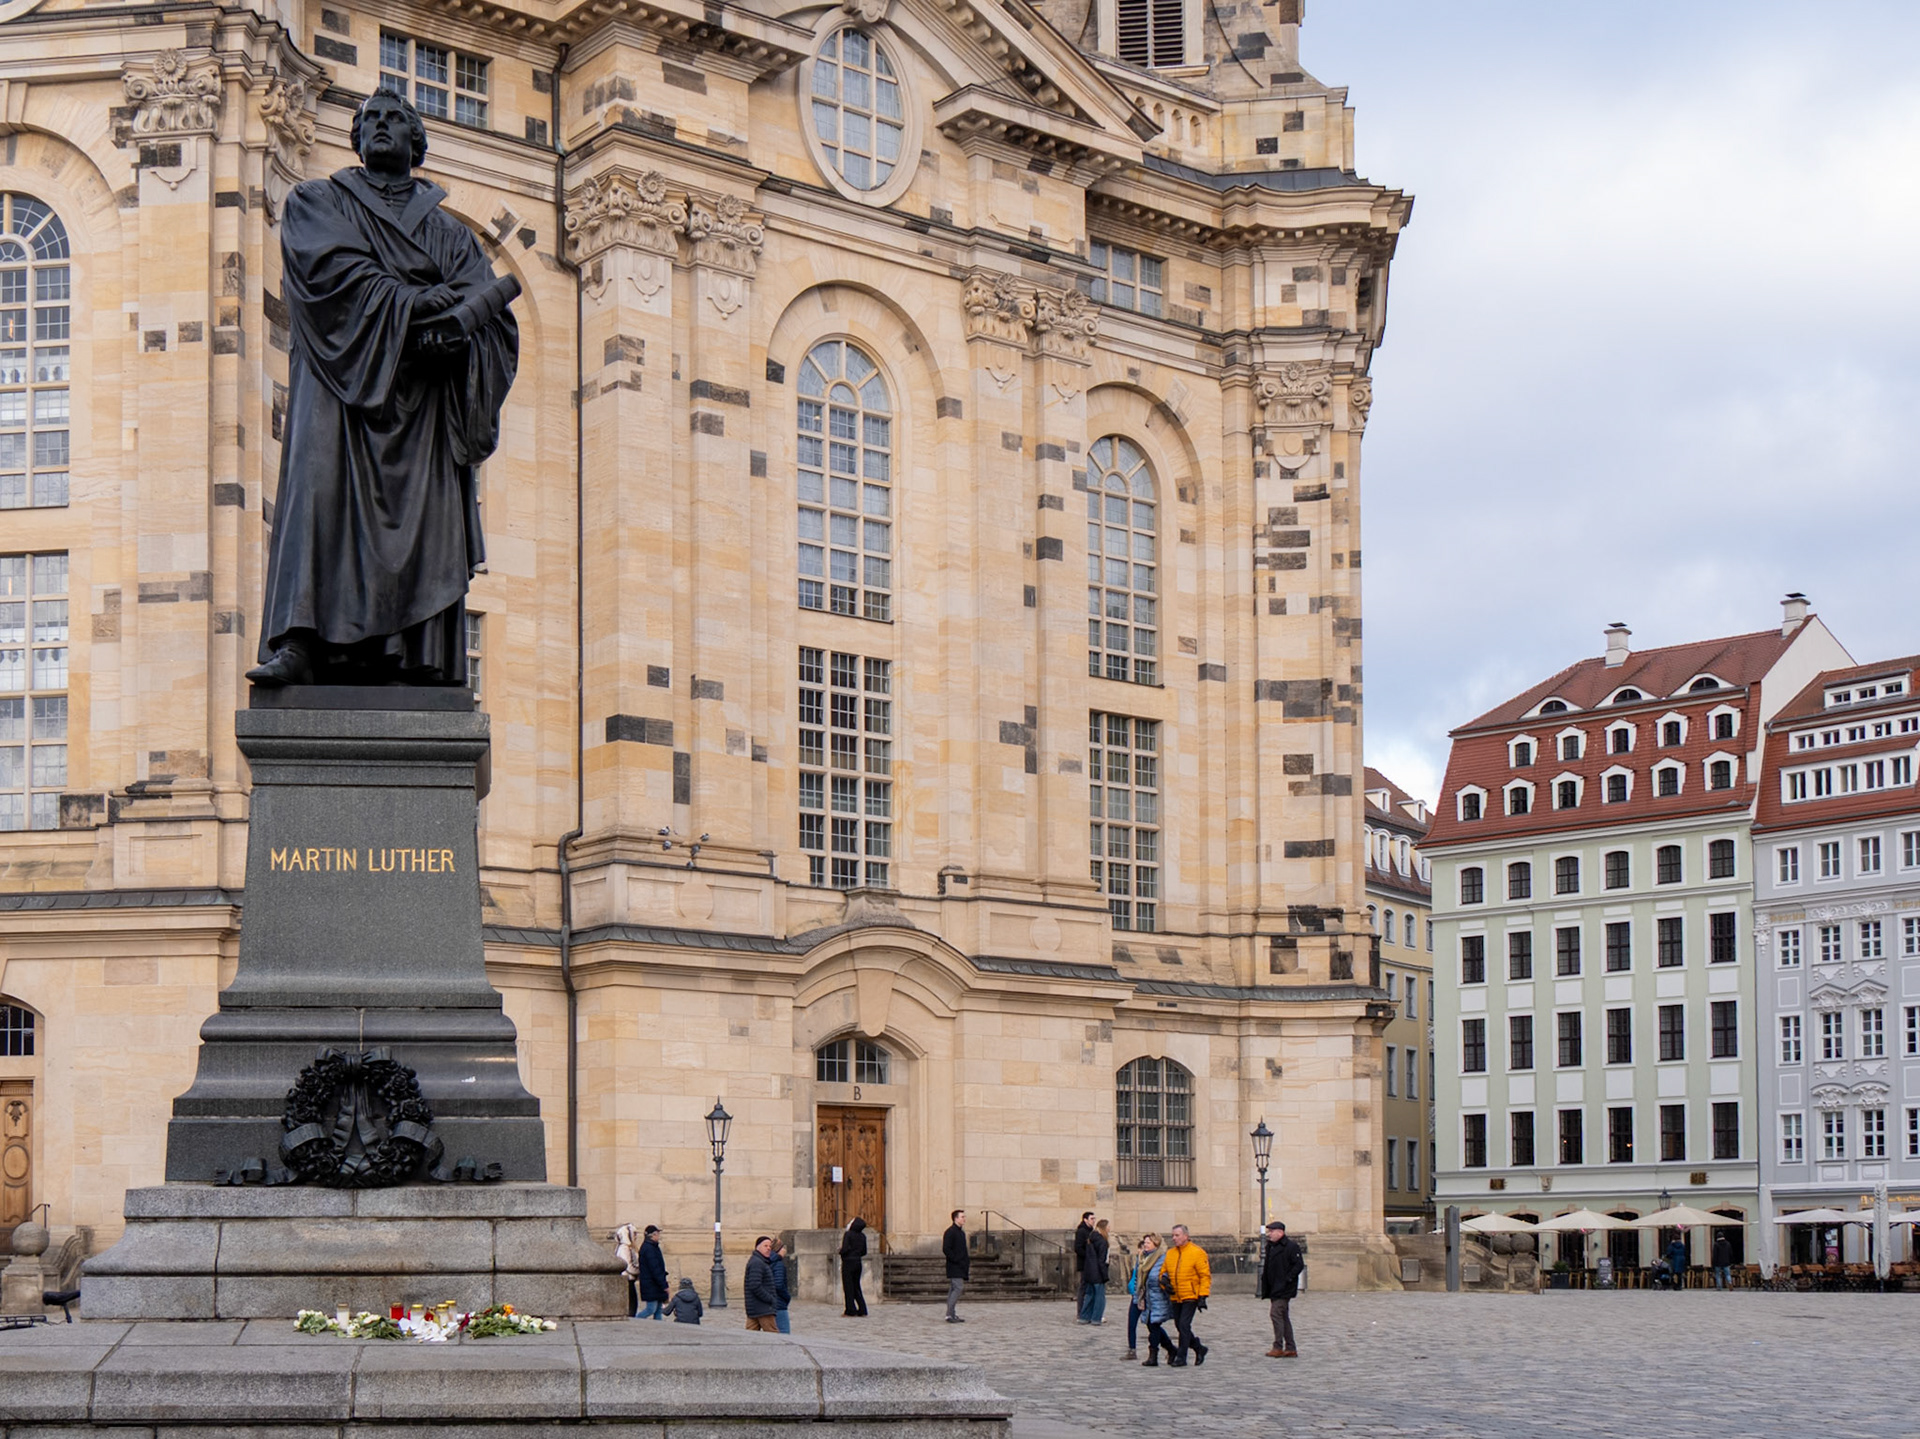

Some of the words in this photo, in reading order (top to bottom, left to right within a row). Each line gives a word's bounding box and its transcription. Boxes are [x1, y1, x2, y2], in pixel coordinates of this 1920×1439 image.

[270, 847, 357, 872] MARTIN
[368, 847, 455, 872] LUTHER
[853, 1085, 862, 1101] B
